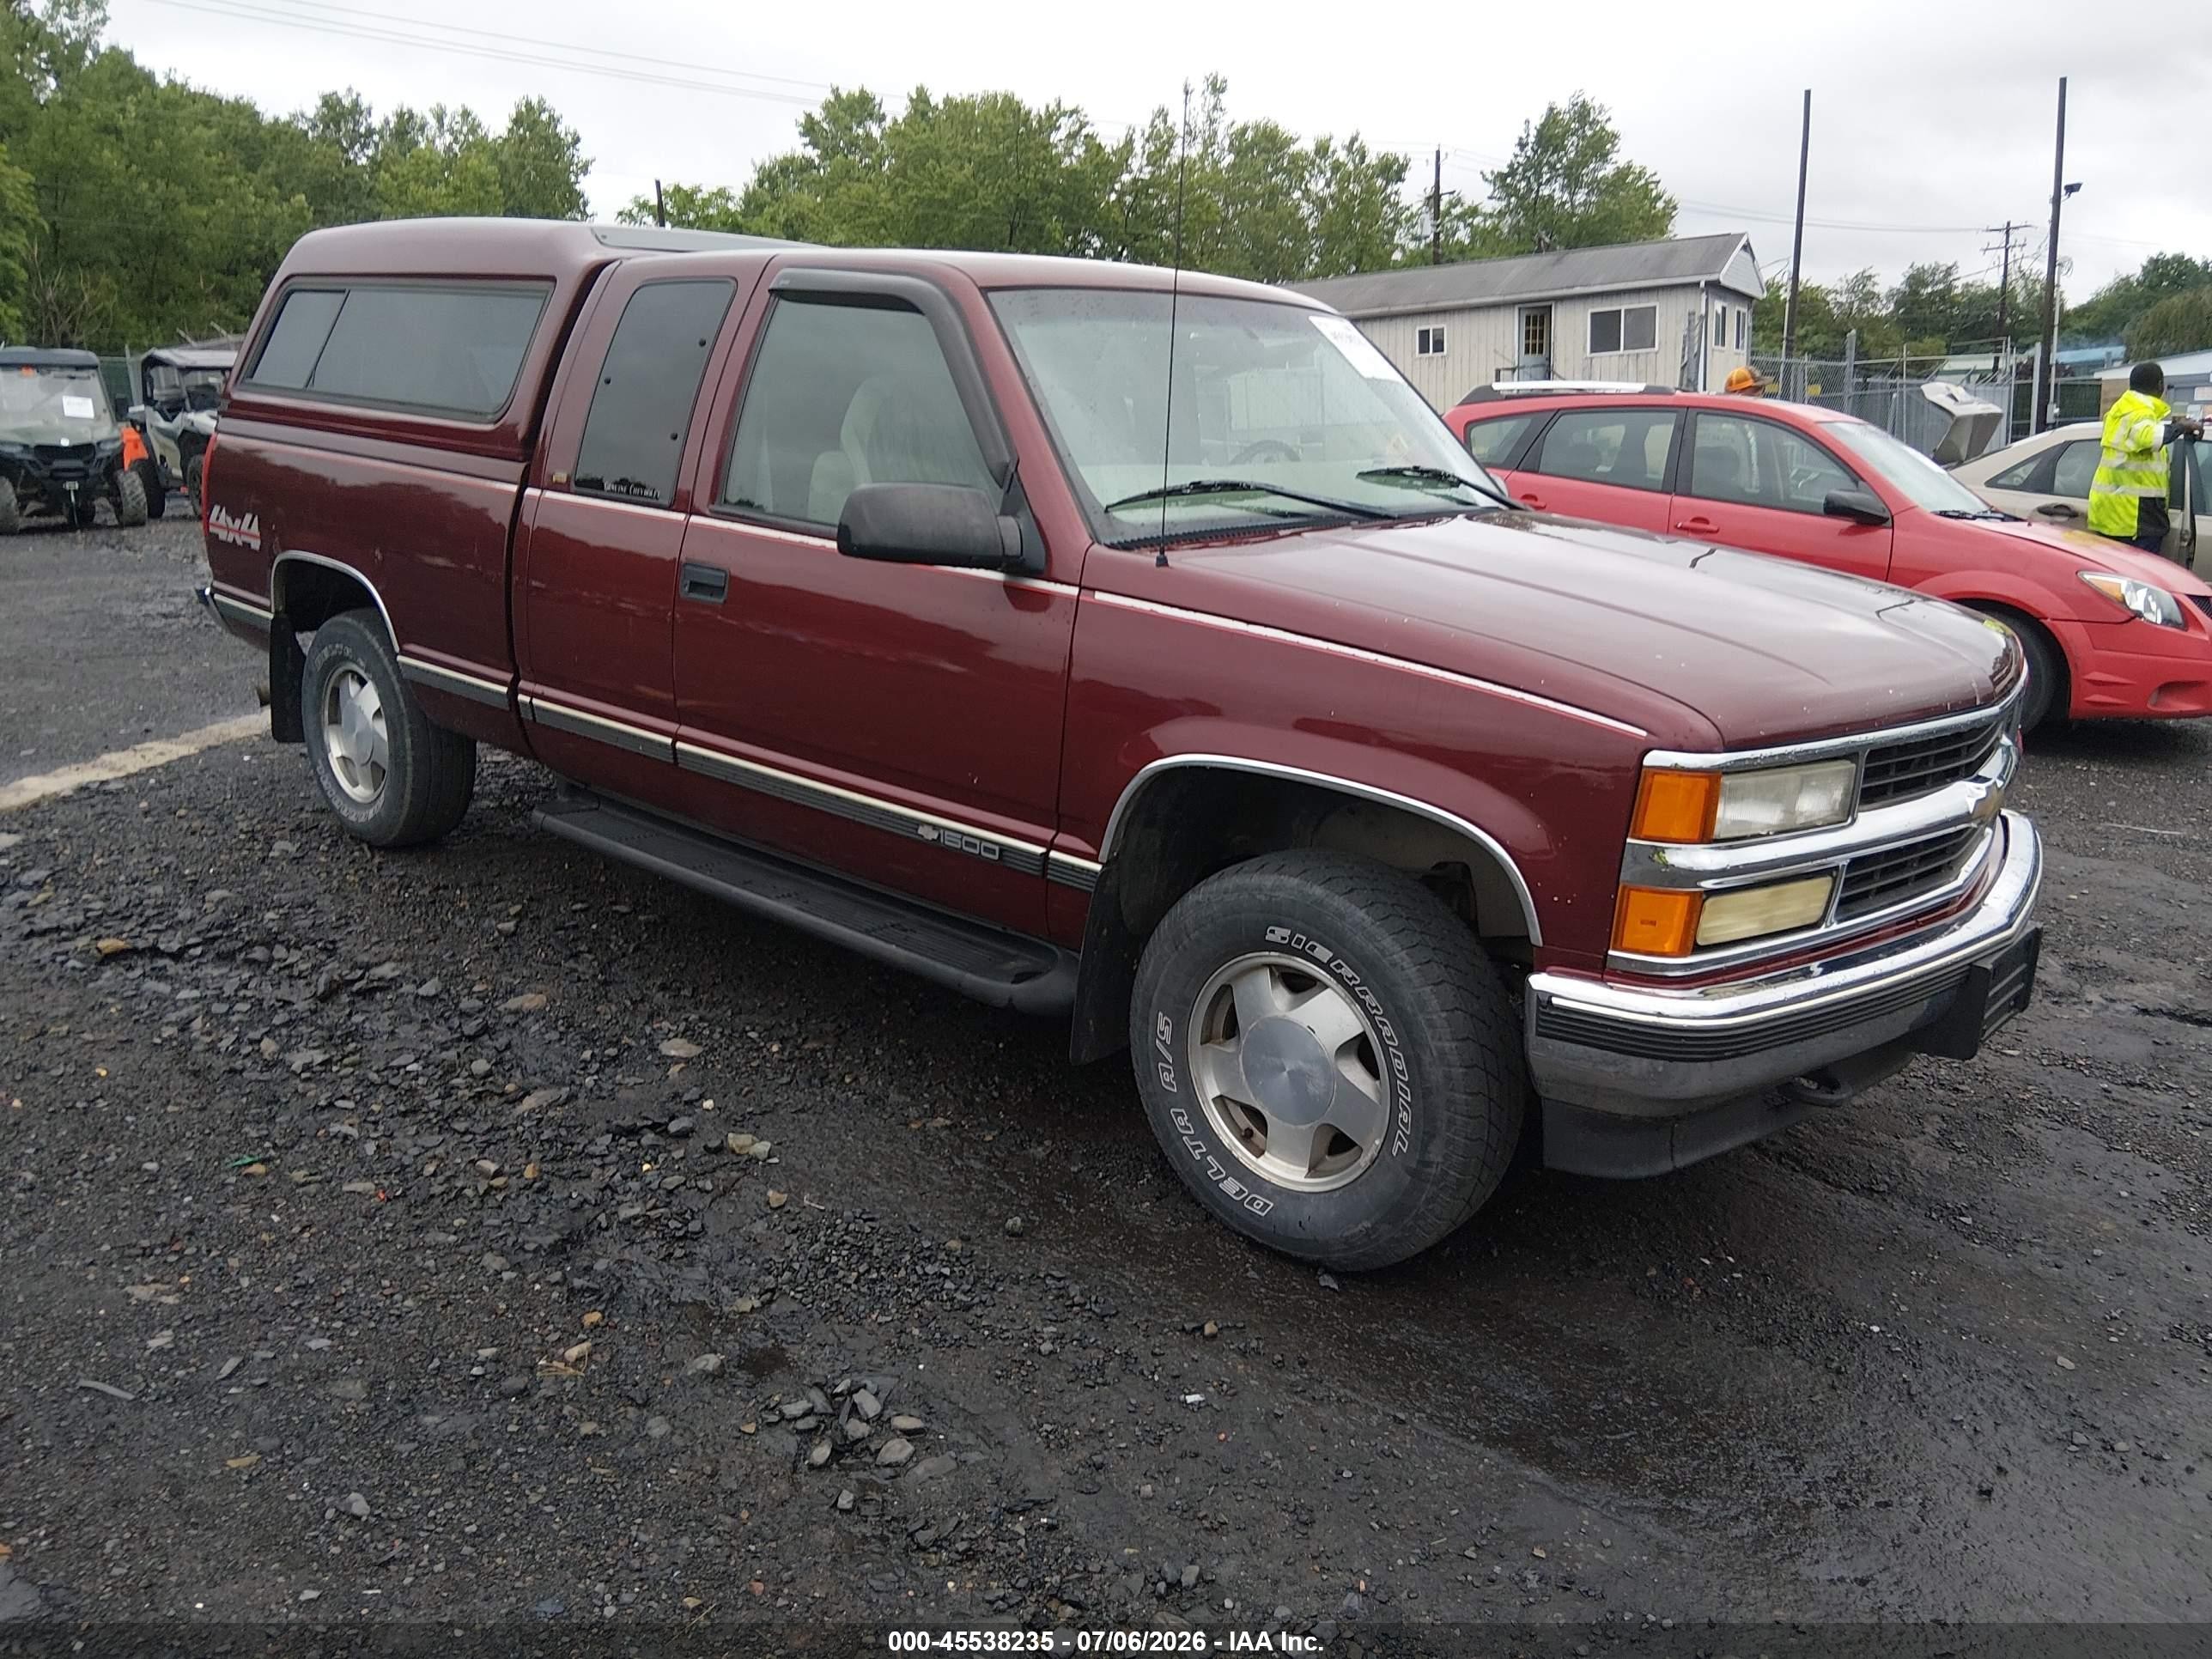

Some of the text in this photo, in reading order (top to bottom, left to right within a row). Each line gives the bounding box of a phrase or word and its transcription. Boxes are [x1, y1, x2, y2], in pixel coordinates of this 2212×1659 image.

[940, 829, 1000, 860] 1500
[1155, 1012, 1274, 1217] DELTA A/S
